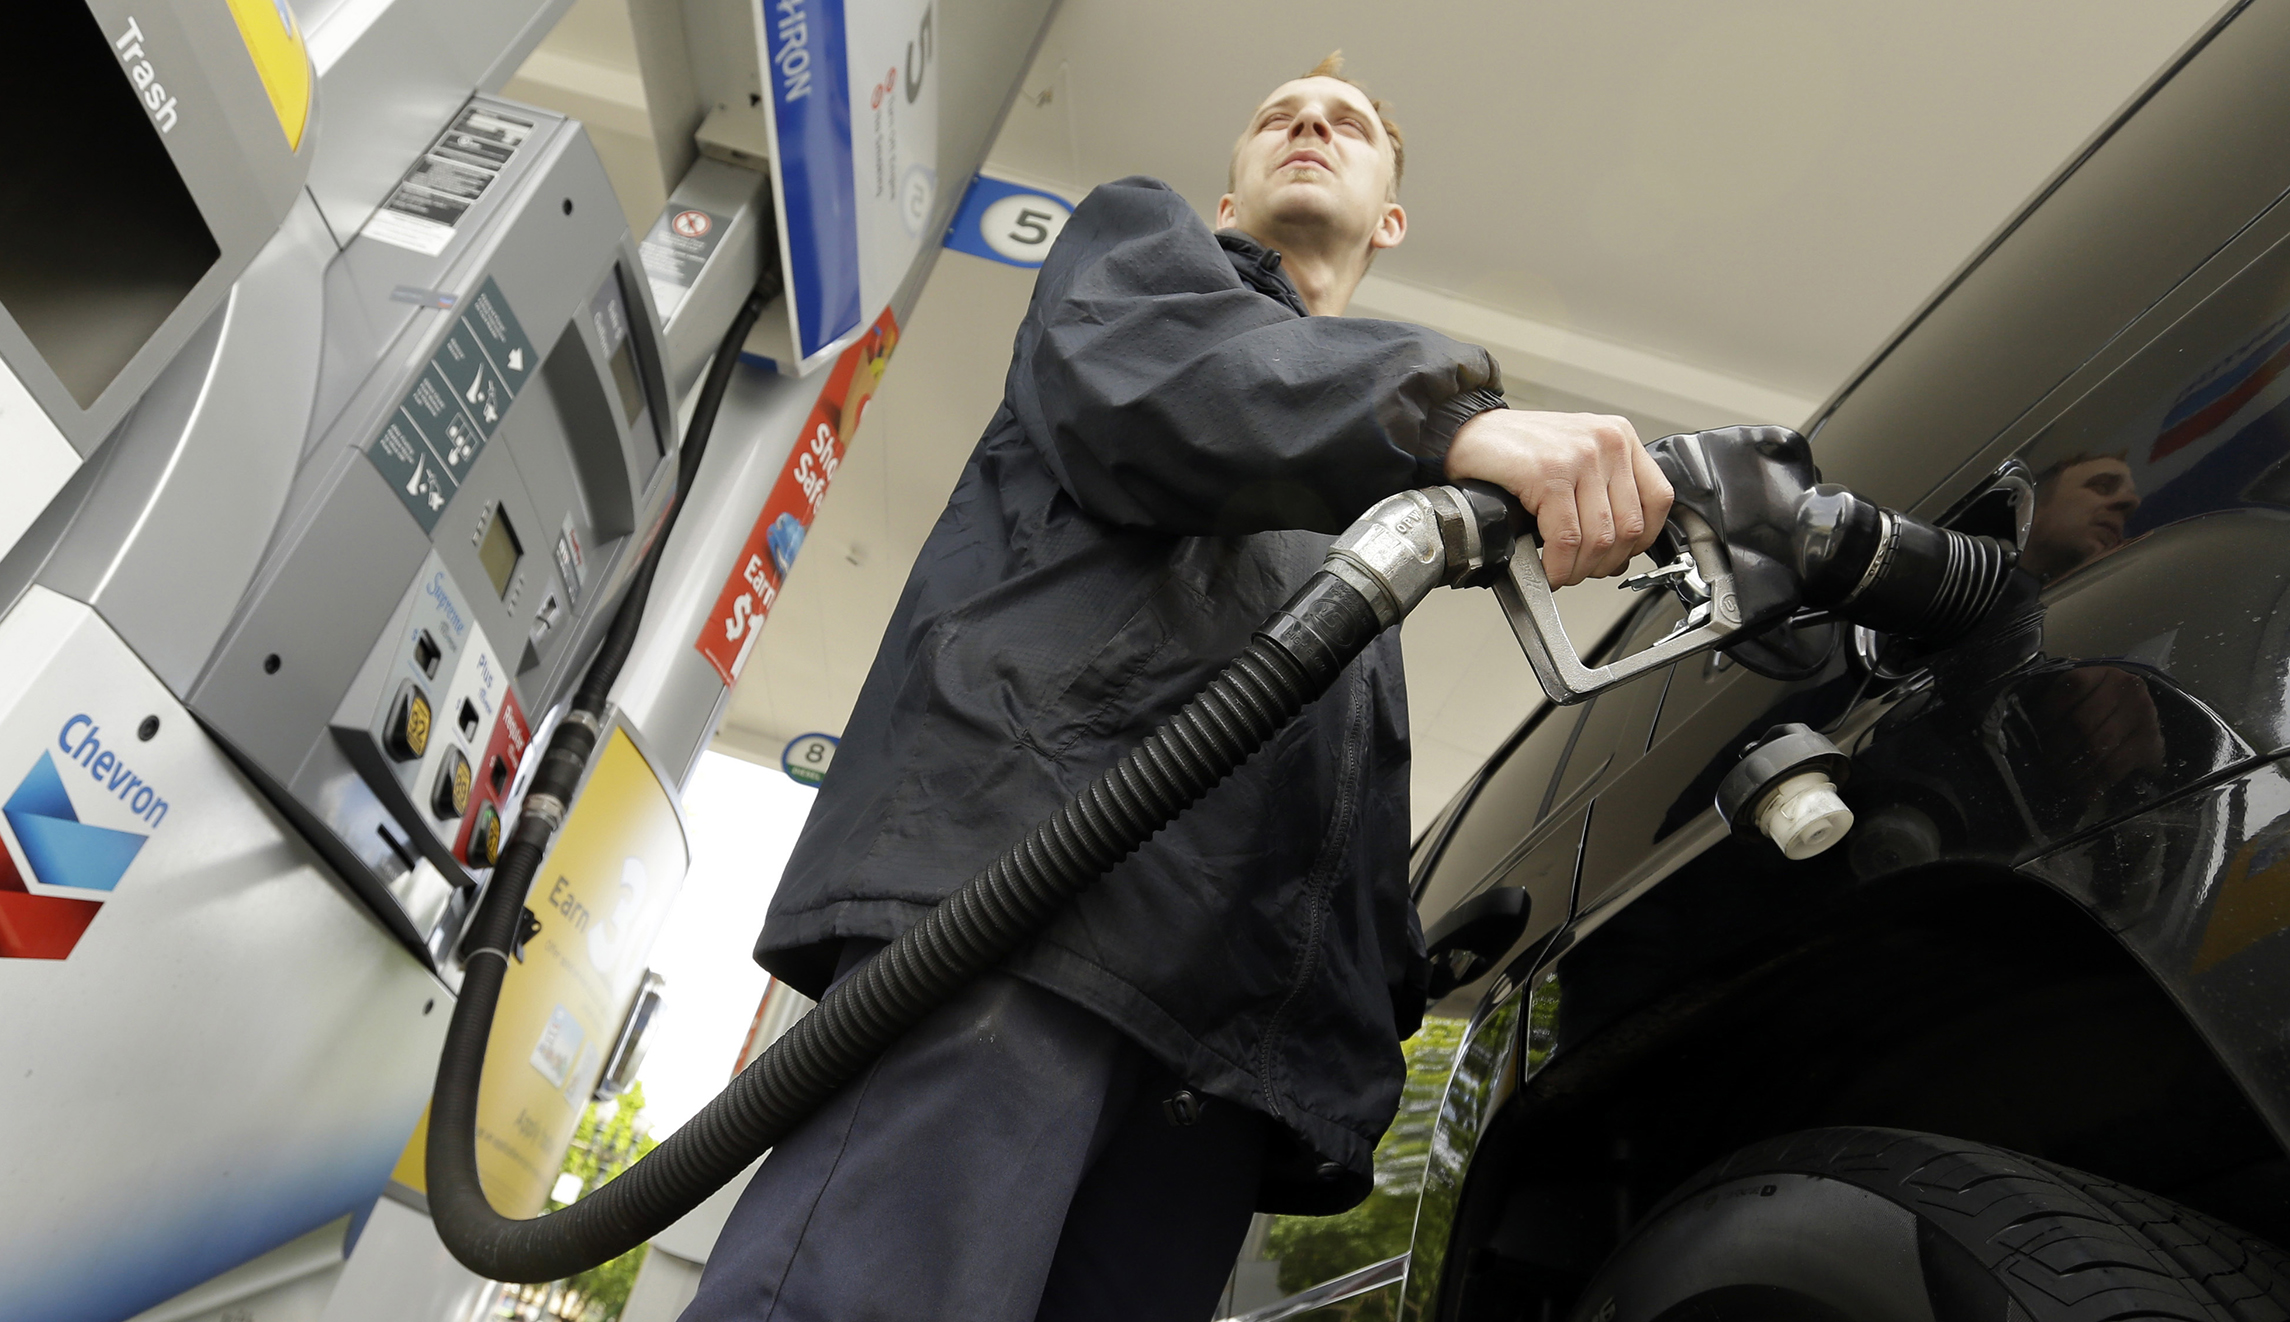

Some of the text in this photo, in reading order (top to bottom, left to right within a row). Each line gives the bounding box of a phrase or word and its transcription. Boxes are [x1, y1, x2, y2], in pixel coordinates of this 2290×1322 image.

[115, 16, 179, 133] Trash
[1007, 207, 1053, 245] 5
[1396, 509, 1422, 534] OPW
[743, 553, 777, 609] Earn
[426, 571, 465, 635] Supreme
[1285, 629, 1308, 647] HIGH
[411, 710, 425, 736] 92
[502, 704, 525, 751] Regular
[58, 712, 170, 830] Chevron
[791, 766, 821, 781] DIESEL
[806, 743, 825, 763] 8
[549, 874, 590, 935] Earn
